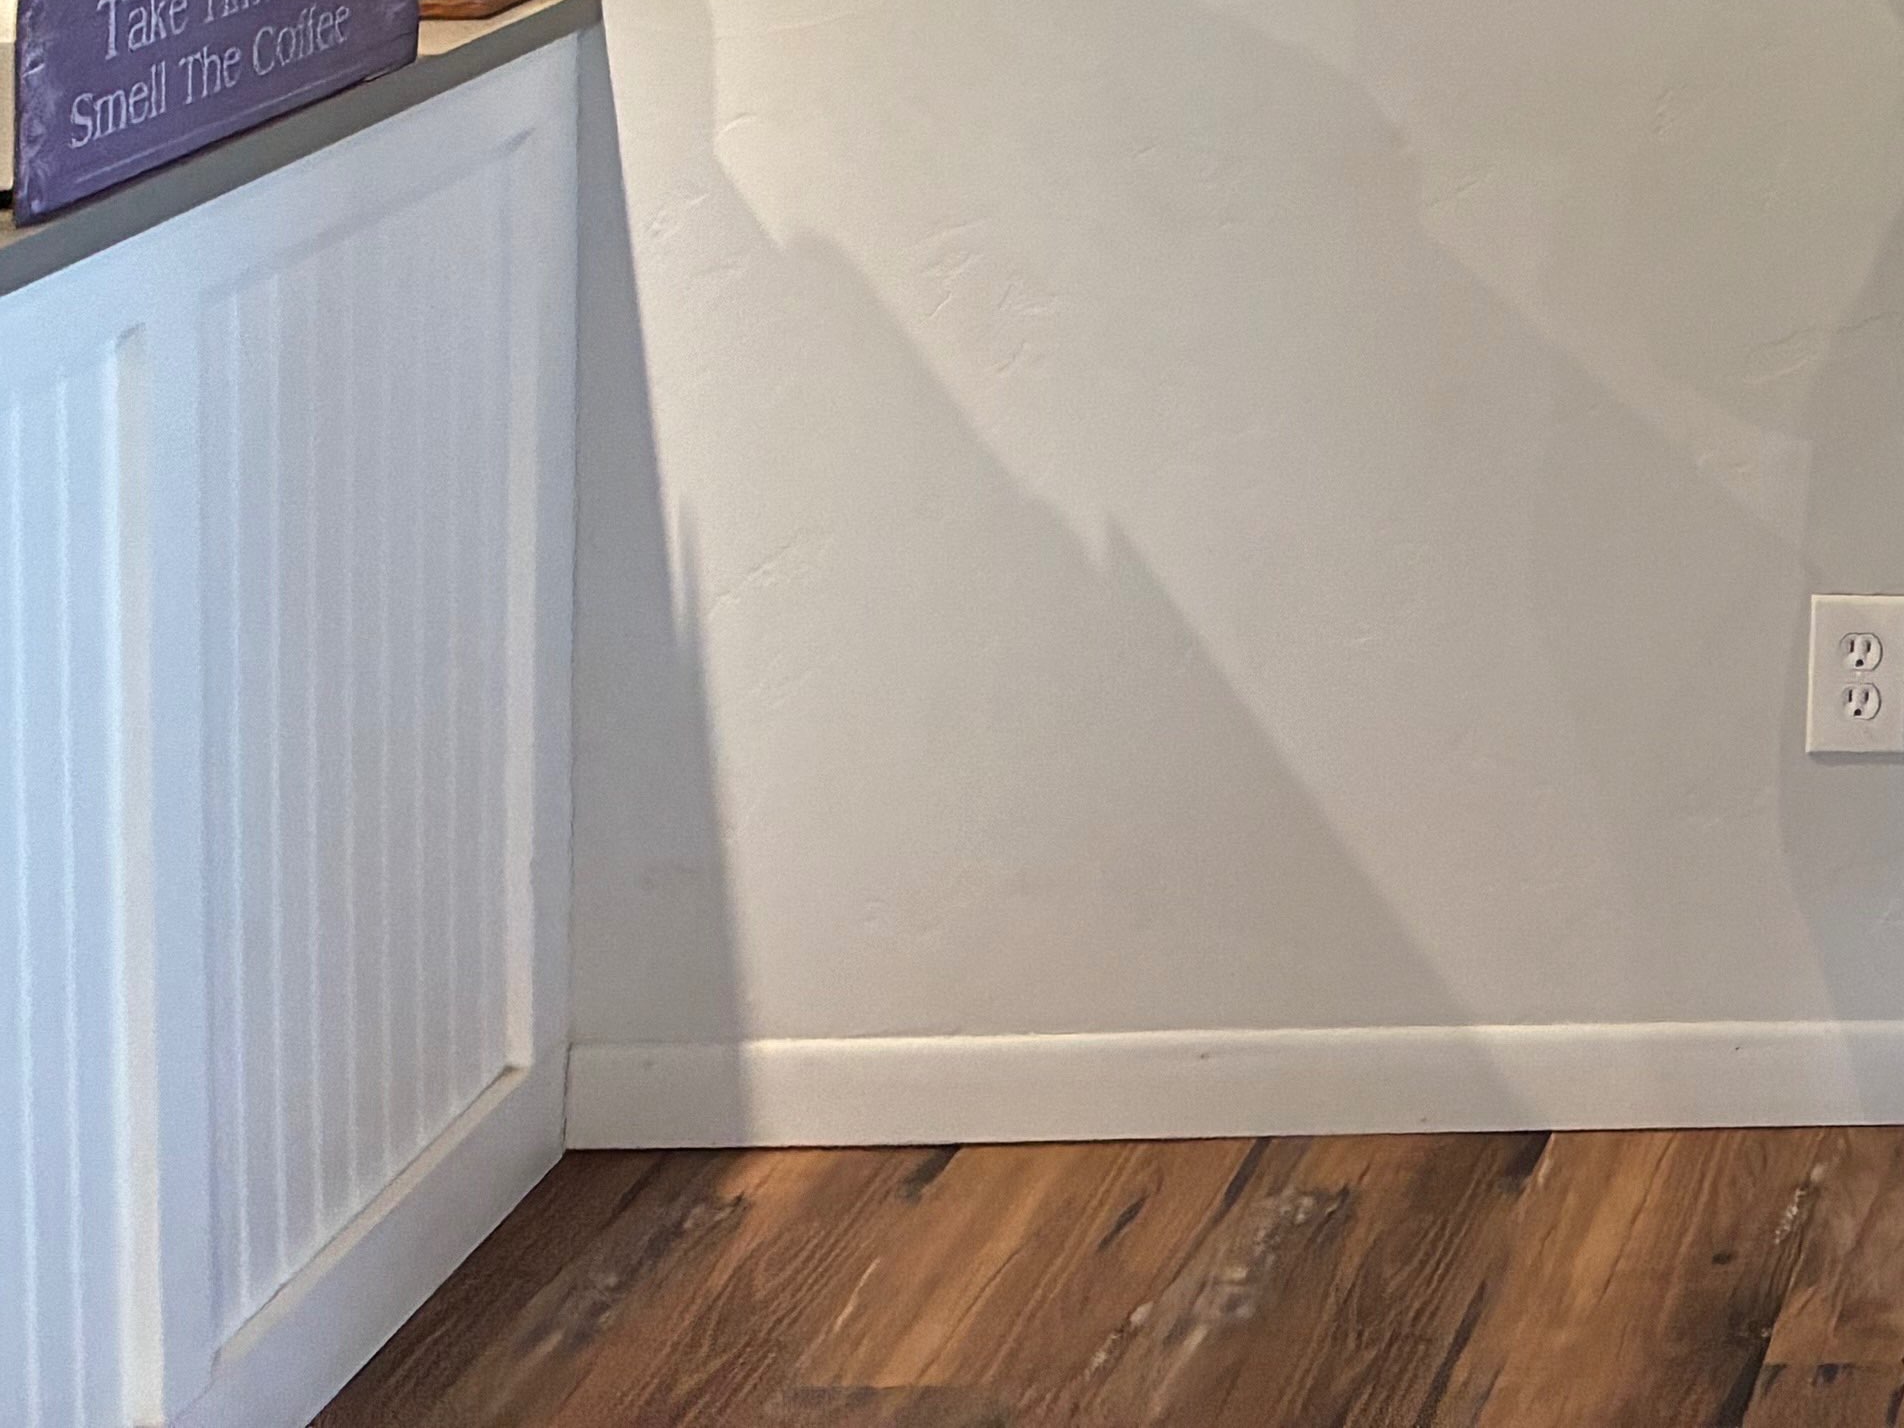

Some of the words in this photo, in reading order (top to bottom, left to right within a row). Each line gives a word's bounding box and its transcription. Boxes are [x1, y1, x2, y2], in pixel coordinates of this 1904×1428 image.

[68, 59, 168, 149] Smell
[178, 42, 243, 105] The
[252, 3, 351, 77] Coffee
